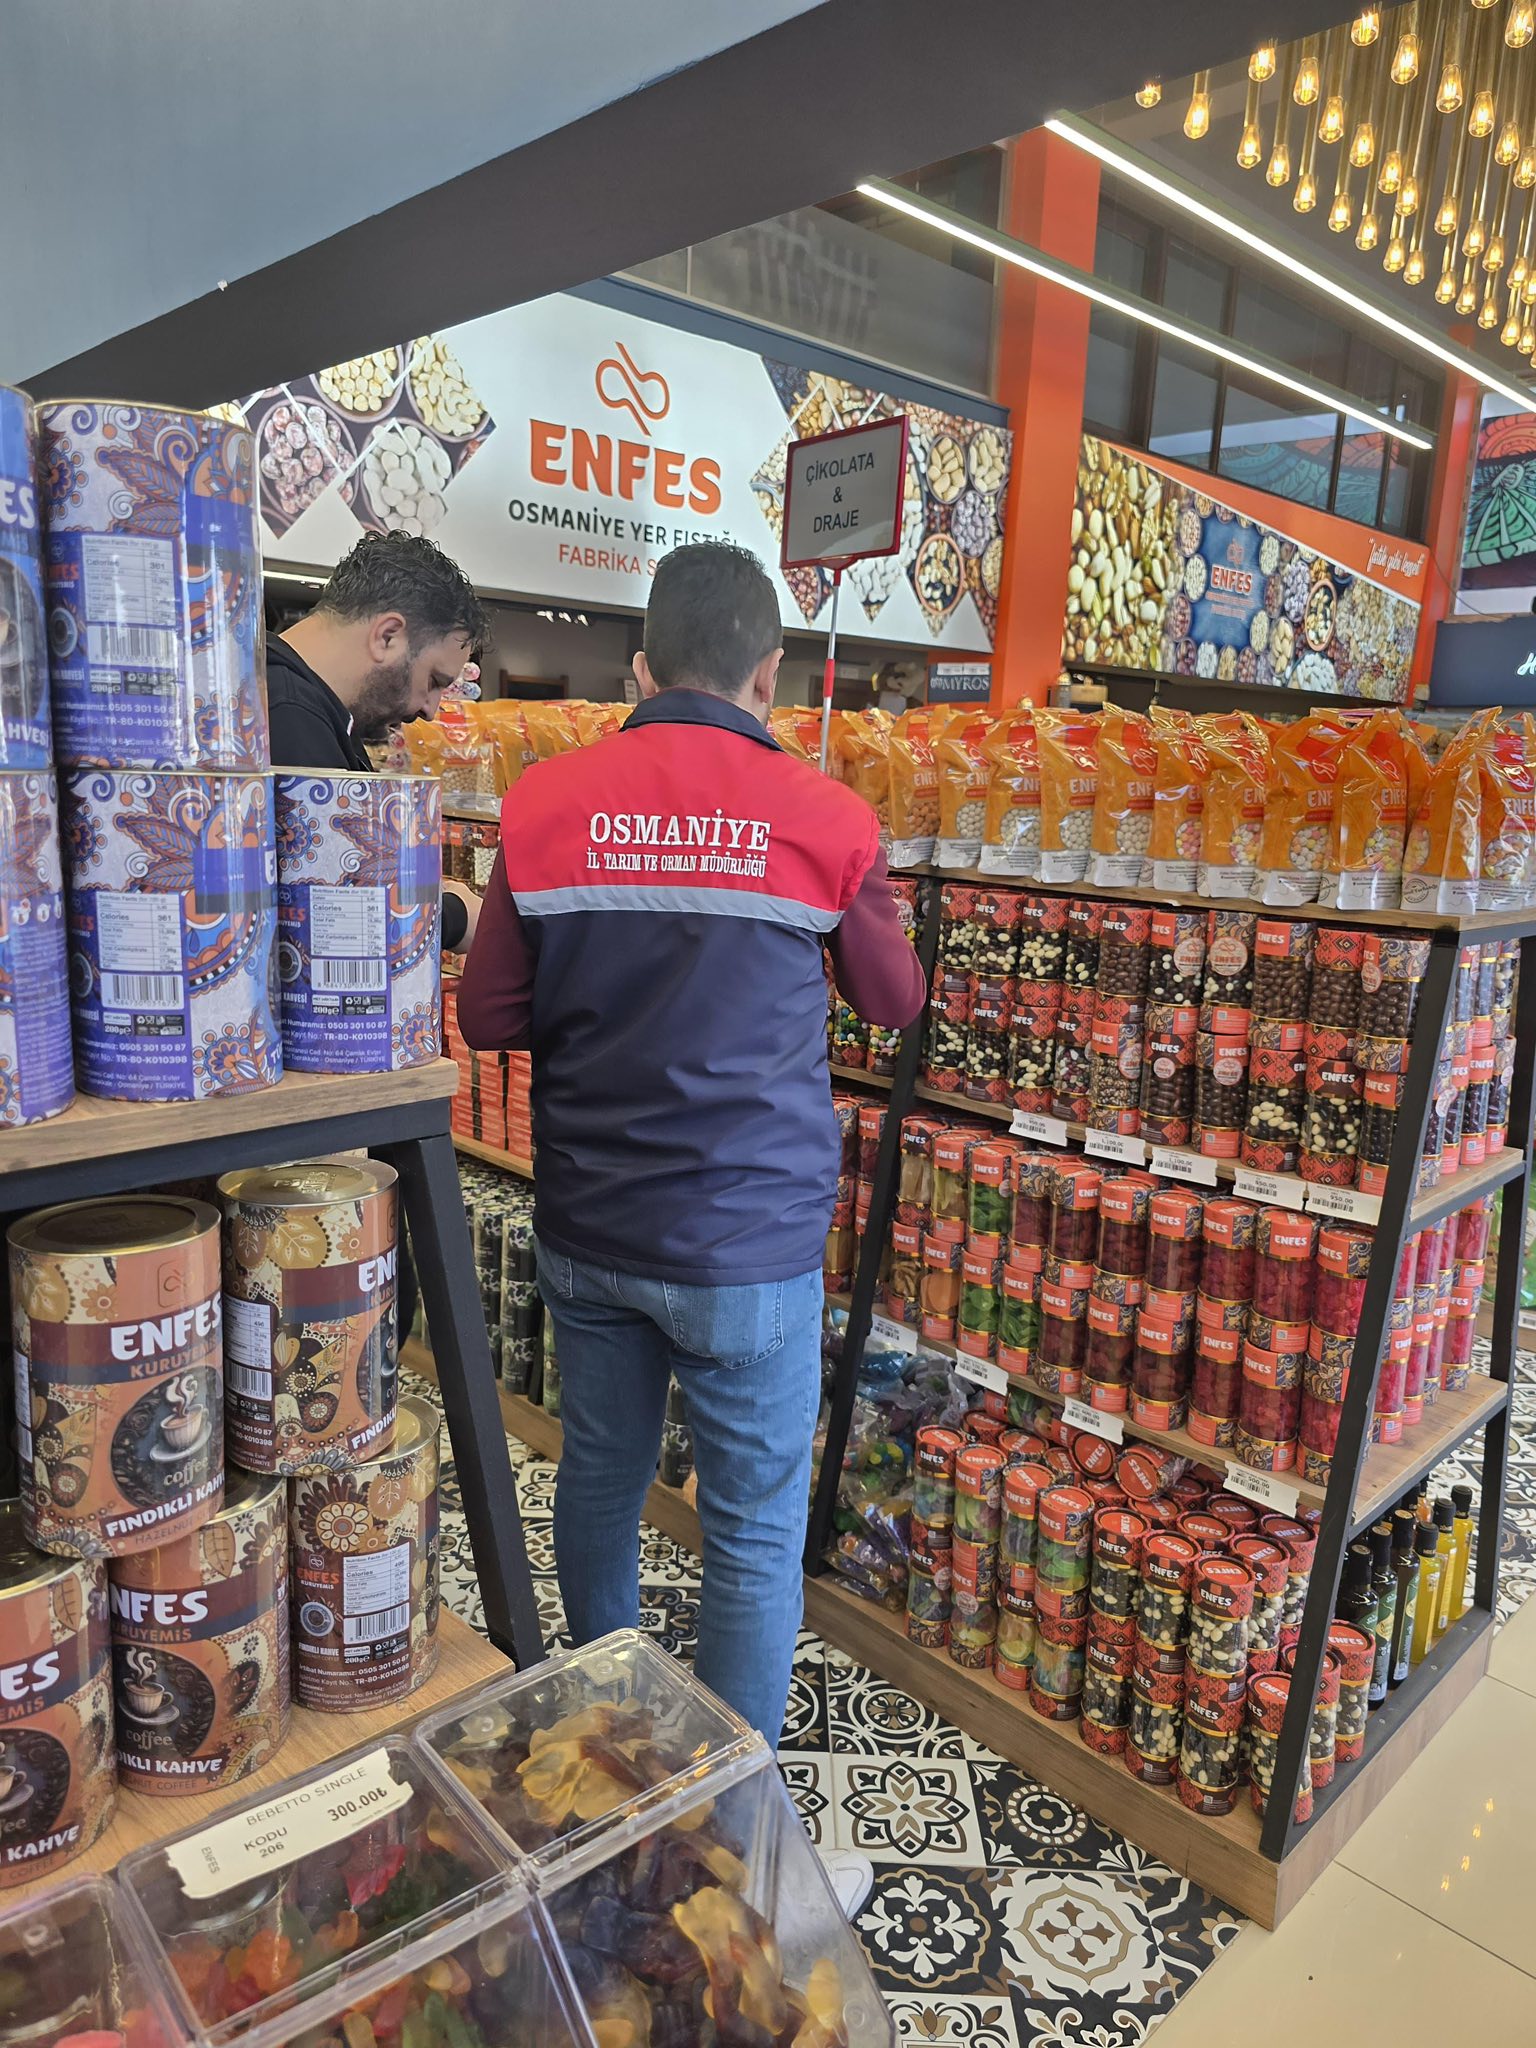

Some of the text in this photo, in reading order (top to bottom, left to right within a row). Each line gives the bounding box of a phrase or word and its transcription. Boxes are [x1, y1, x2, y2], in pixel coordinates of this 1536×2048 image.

[528, 419, 722, 515] ENFES
[805, 451, 875, 487] ÇİKOLATA
[832, 486, 843, 503] &
[508, 499, 625, 539] OSMANİYE
[630, 520, 667, 547] YER
[813, 509, 860, 534] DRAJE
[559, 543, 641, 575] FABRİKA
[1211, 564, 1252, 595] ENFES
[1069, 778, 1098, 793] ENF
[589, 808, 771, 852] OSMANİYE
[587, 847, 767, 878] İL TARIM VE ORMAN MÜDÜRLÜĞÜ
[1102, 919, 1127, 931] ENFES
[1258, 932, 1285, 945] ENFES
[1151, 1041, 1180, 1053] ENFES
[1321, 1071, 1355, 1084] ENFES
[1365, 1078, 1391, 1093] ENFES
[1102, 1197, 1128, 1211] ENFES
[1153, 1212, 1182, 1227] ENFES
[1274, 1234, 1307, 1247] ENFES
[1140, 1327, 1168, 1342] ENFES
[1204, 1335, 1234, 1350] ENFES
[1244, 1357, 1271, 1374] ENFES
[920, 1451, 944, 1464] ENFES
[1085, 1443, 1106, 1469] ENFES
[1128, 1458, 1153, 1490] ENFES
[1006, 1490, 1031, 1507] ENFES
[1051, 1493, 1083, 1510] ENFES
[106, 1493, 193, 1537] FINDIKLI
[1188, 1522, 1223, 1537] ENFES
[1099, 1538, 1127, 1555] ENFES
[1156, 1537, 1189, 1556] ENFES
[1249, 1546, 1276, 1561] ENFES
[296, 1567, 340, 1585] ENFES
[1150, 1562, 1180, 1579] ENFES
[1206, 1567, 1243, 1575] ENFES
[109, 1582, 209, 1626] NFES
[1006, 1592, 1033, 1608] ENFES
[1200, 1589, 1232, 1606] ENFES
[1090, 1646, 1116, 1664] ENFES
[358, 1667, 378, 1675] 0505
[378, 1662, 391, 1671] 301
[1189, 1699, 1219, 1721] ENFES
[126, 1729, 173, 1751] coffee
[155, 1758, 223, 1774] KAHVE
[157, 1781, 197, 1791] COFFEE
[246, 1767, 367, 1826] BEBETTO SINGLE
[8, 1825, 80, 1862] KAHVE
[243, 1826, 288, 1852] KODU
[259, 1841, 285, 1859] 206
[200, 1846, 221, 1875] ENFES
